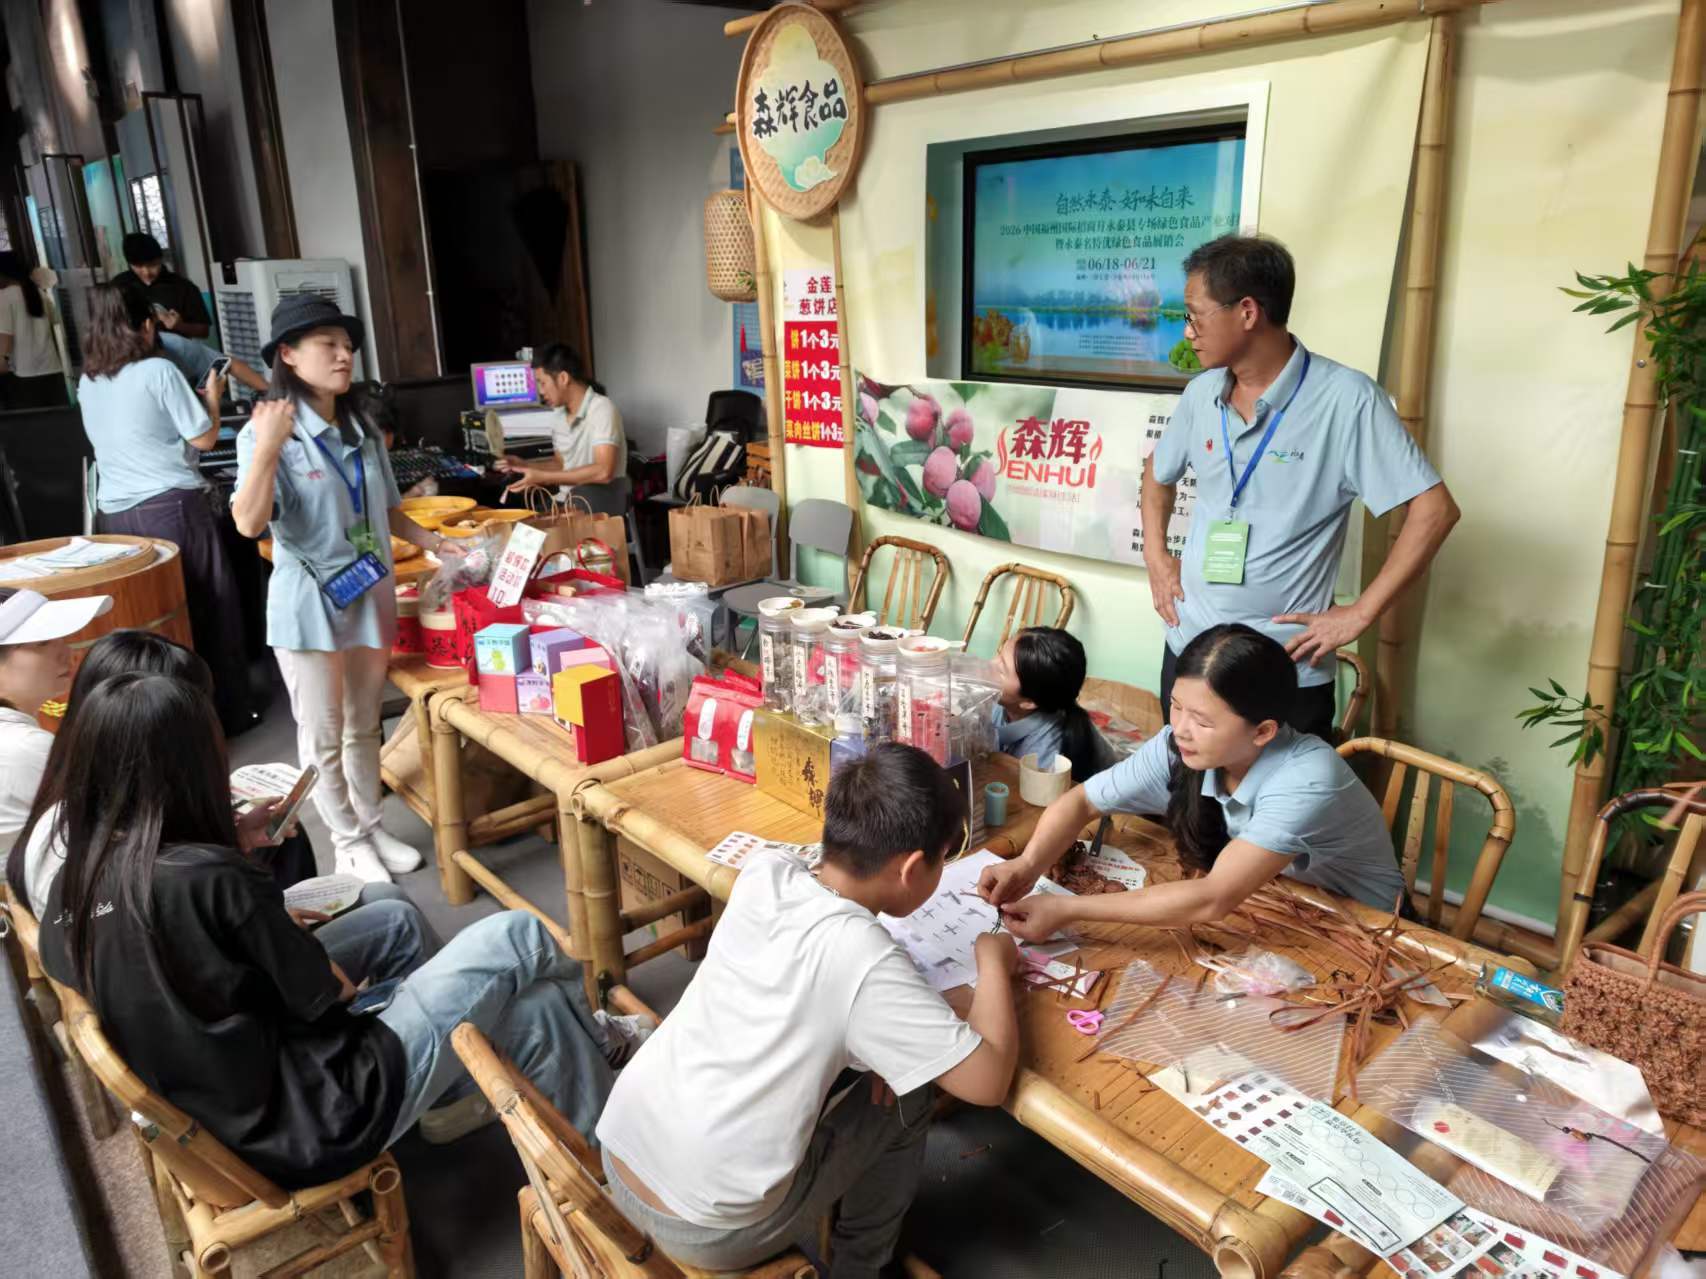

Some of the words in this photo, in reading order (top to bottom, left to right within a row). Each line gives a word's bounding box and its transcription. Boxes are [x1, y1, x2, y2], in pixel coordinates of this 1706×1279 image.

[752, 78, 848, 139] 森辉食品
[1010, 416, 1091, 464] 森辉
